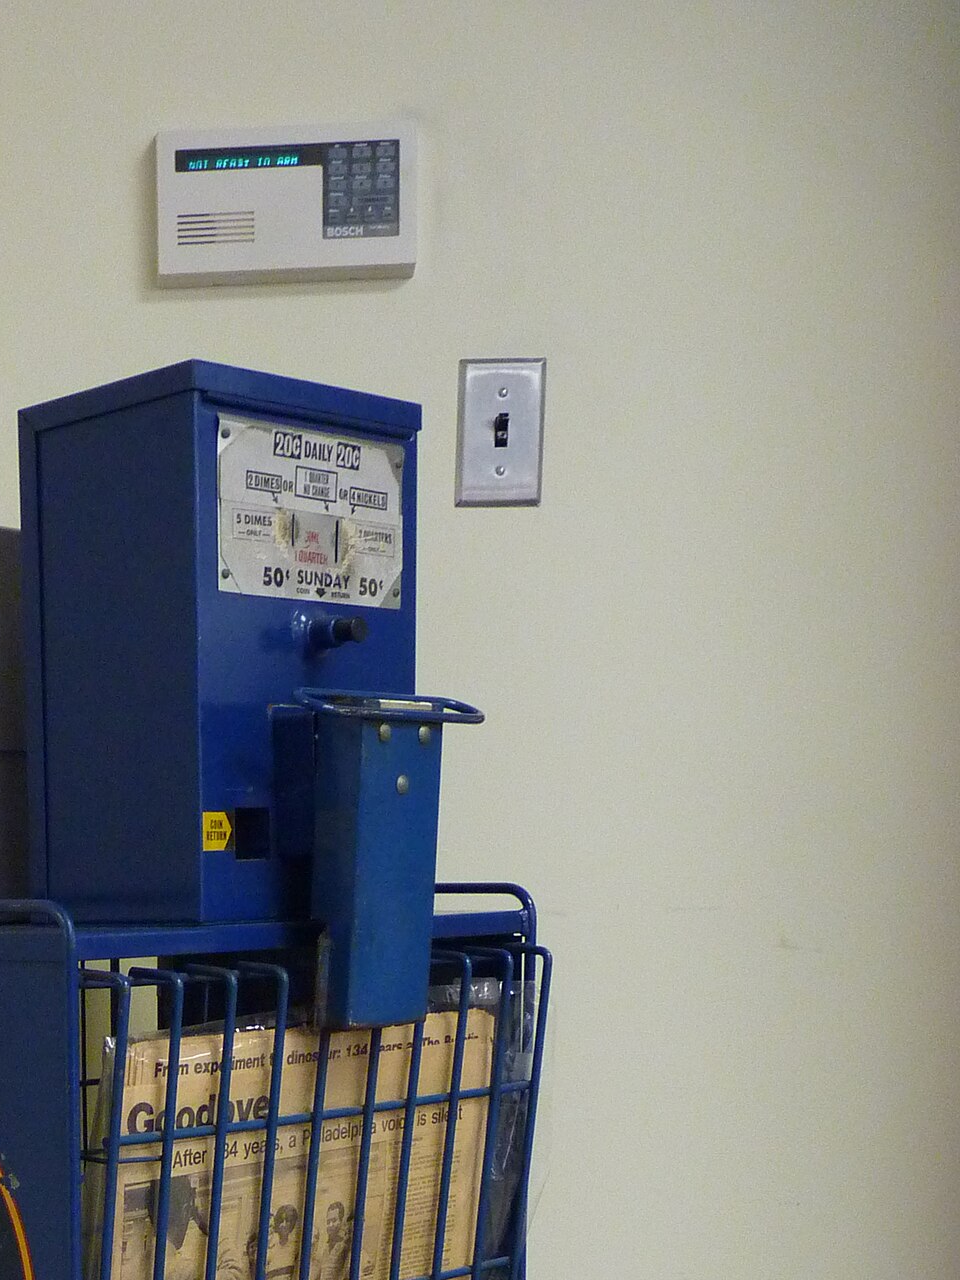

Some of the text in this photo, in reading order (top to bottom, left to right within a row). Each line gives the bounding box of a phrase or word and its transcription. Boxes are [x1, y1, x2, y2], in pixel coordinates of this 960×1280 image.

[326, 226, 365, 238] BOSCH
[275, 432, 361, 470] 20¢ DAILY 20¢
[309, 472, 330, 485] QUARTER
[282, 480, 294, 493] OR
[339, 488, 349, 501] OR
[356, 492, 387, 510] NICKELS
[236, 514, 273, 527] 5 DIMES
[298, 551, 328, 565] QUARTER
[297, 569, 350, 589] SUNDAY
[154, 1061, 189, 1078] Frm
[193, 1053, 266, 1075] expiment
[286, 1048, 341, 1066] dinosur:
[172, 1148, 208, 1169] After
[243, 1138, 284, 1160] yeas,
[288, 1136, 297, 1149] a
[381, 1115, 409, 1132] voic
[416, 1110, 427, 1126] is
[431, 1107, 463, 1125] silet
